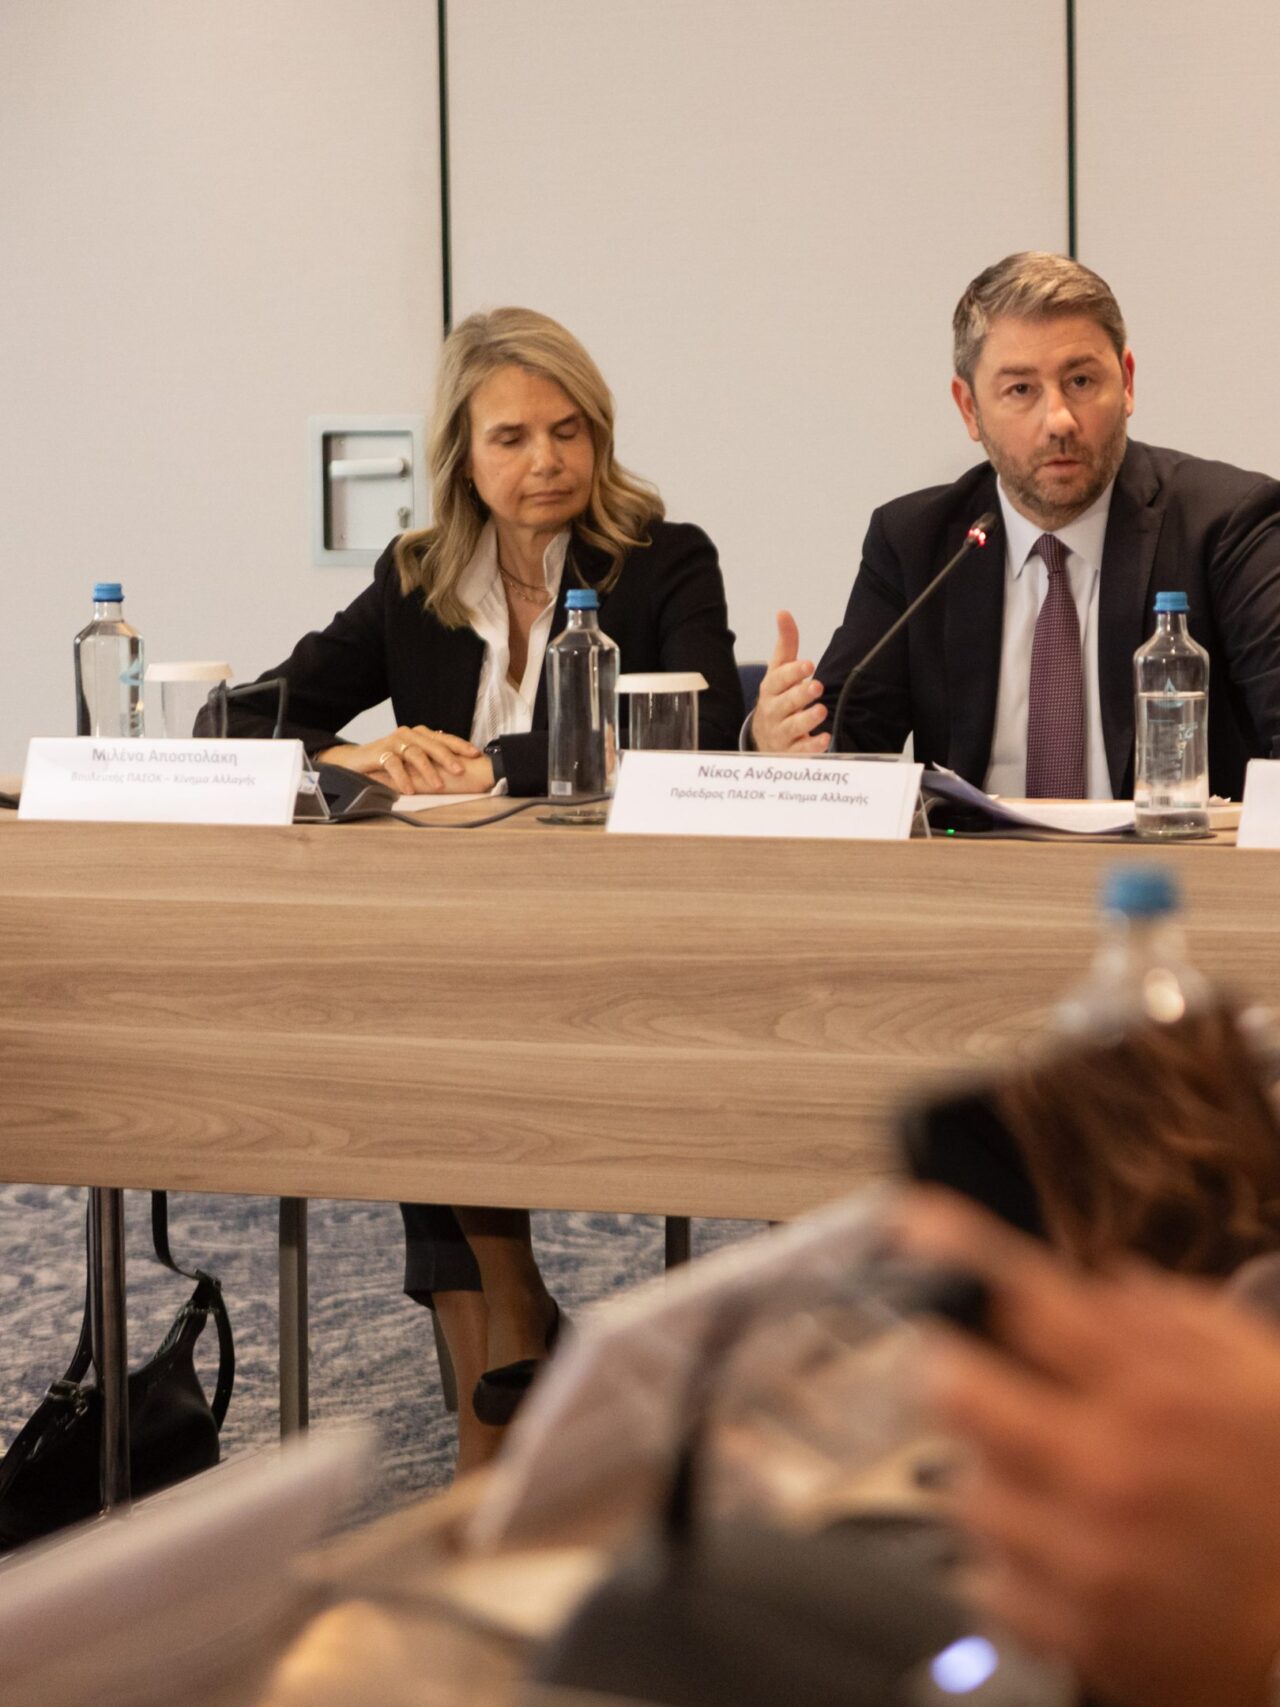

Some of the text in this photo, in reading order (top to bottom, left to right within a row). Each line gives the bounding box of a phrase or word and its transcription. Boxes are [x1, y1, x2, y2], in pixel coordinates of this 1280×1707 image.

[92, 748, 239, 767] Μιλένα Αποστολάκη
[697, 765, 850, 785] Νίκος Ανδρουλάκης
[670, 786, 725, 800] Πρόεδρος
[727, 788, 766, 800] ΠΑΣΟΚ
[778, 791, 818, 804] Κίνημα
[820, 793, 870, 806] Αλλαγής
